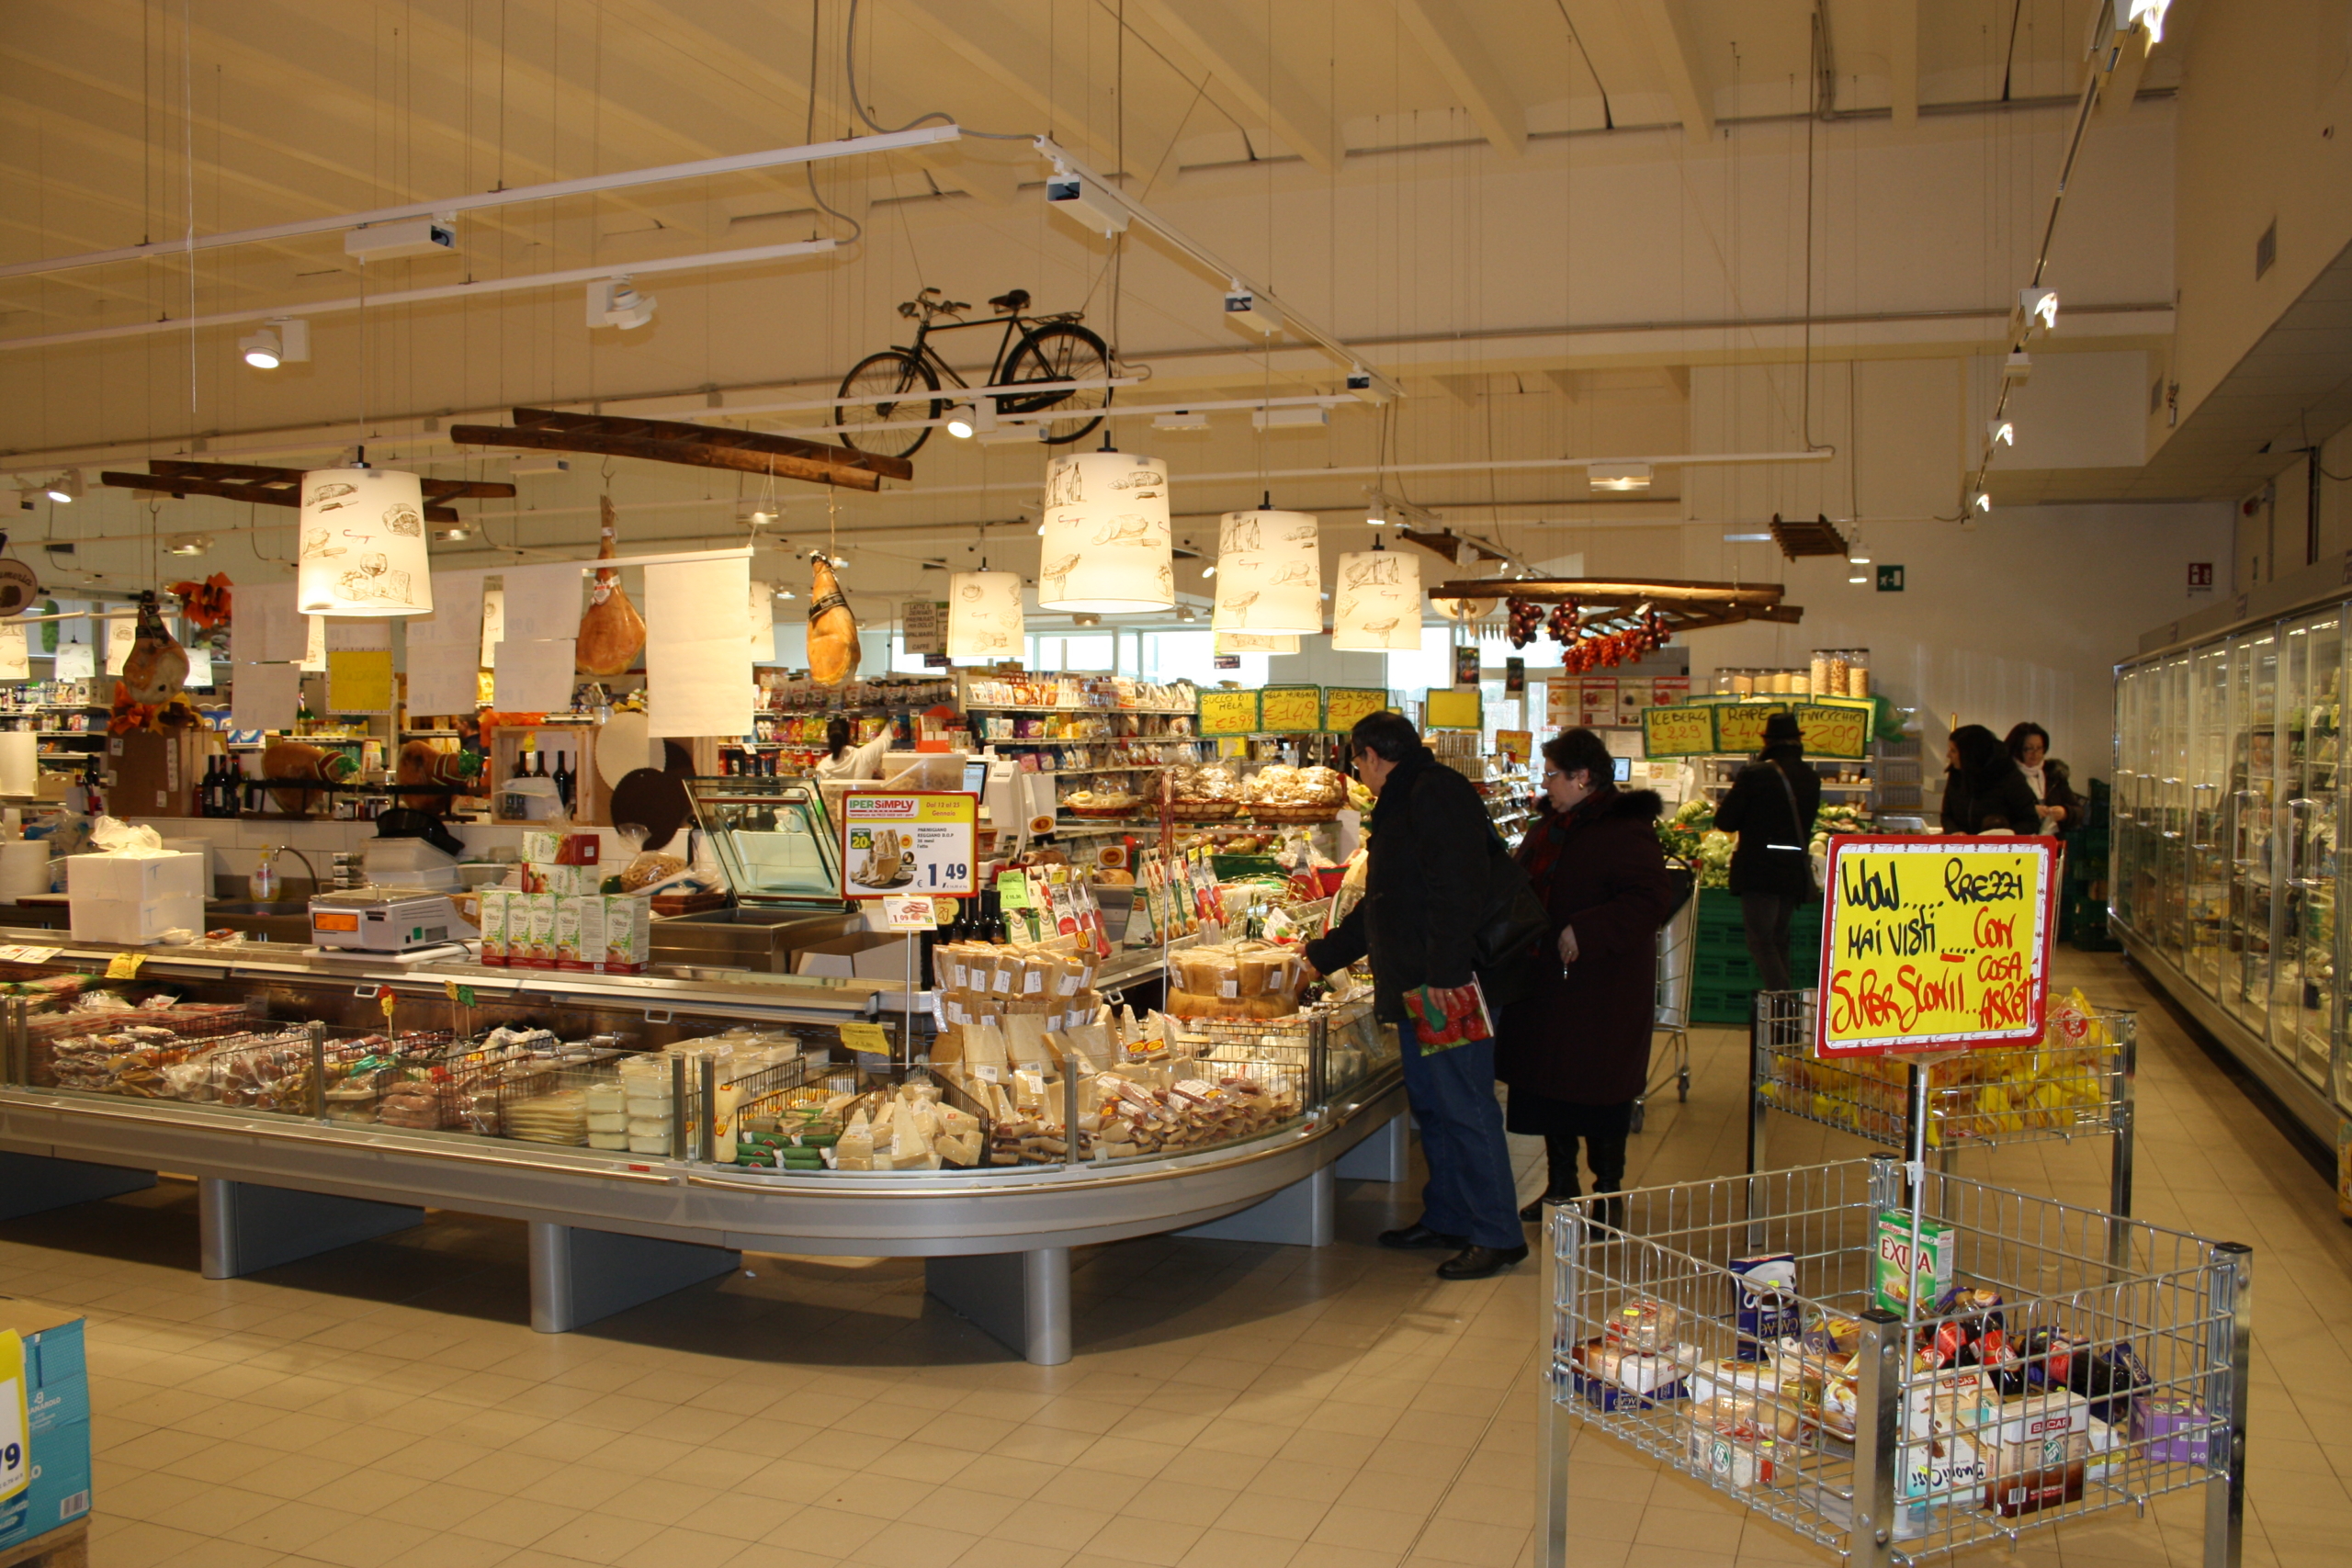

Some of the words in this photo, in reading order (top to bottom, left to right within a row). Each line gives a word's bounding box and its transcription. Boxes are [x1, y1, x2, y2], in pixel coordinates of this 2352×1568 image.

[1203, 695, 1233, 705] SUCCO
[1329, 692, 1352, 700] MELA
[1651, 711, 1707, 726] ICEBERG
[1727, 708, 1769, 721] RAPE
[1944, 857, 2023, 906] PREZZI
[1848, 919, 1883, 960] MAI
[1973, 906, 2017, 950] CON
[1977, 952, 2022, 983] COSA
[1831, 968, 1904, 1033] SUPER
[1882, 1236, 1932, 1275] EXTA
